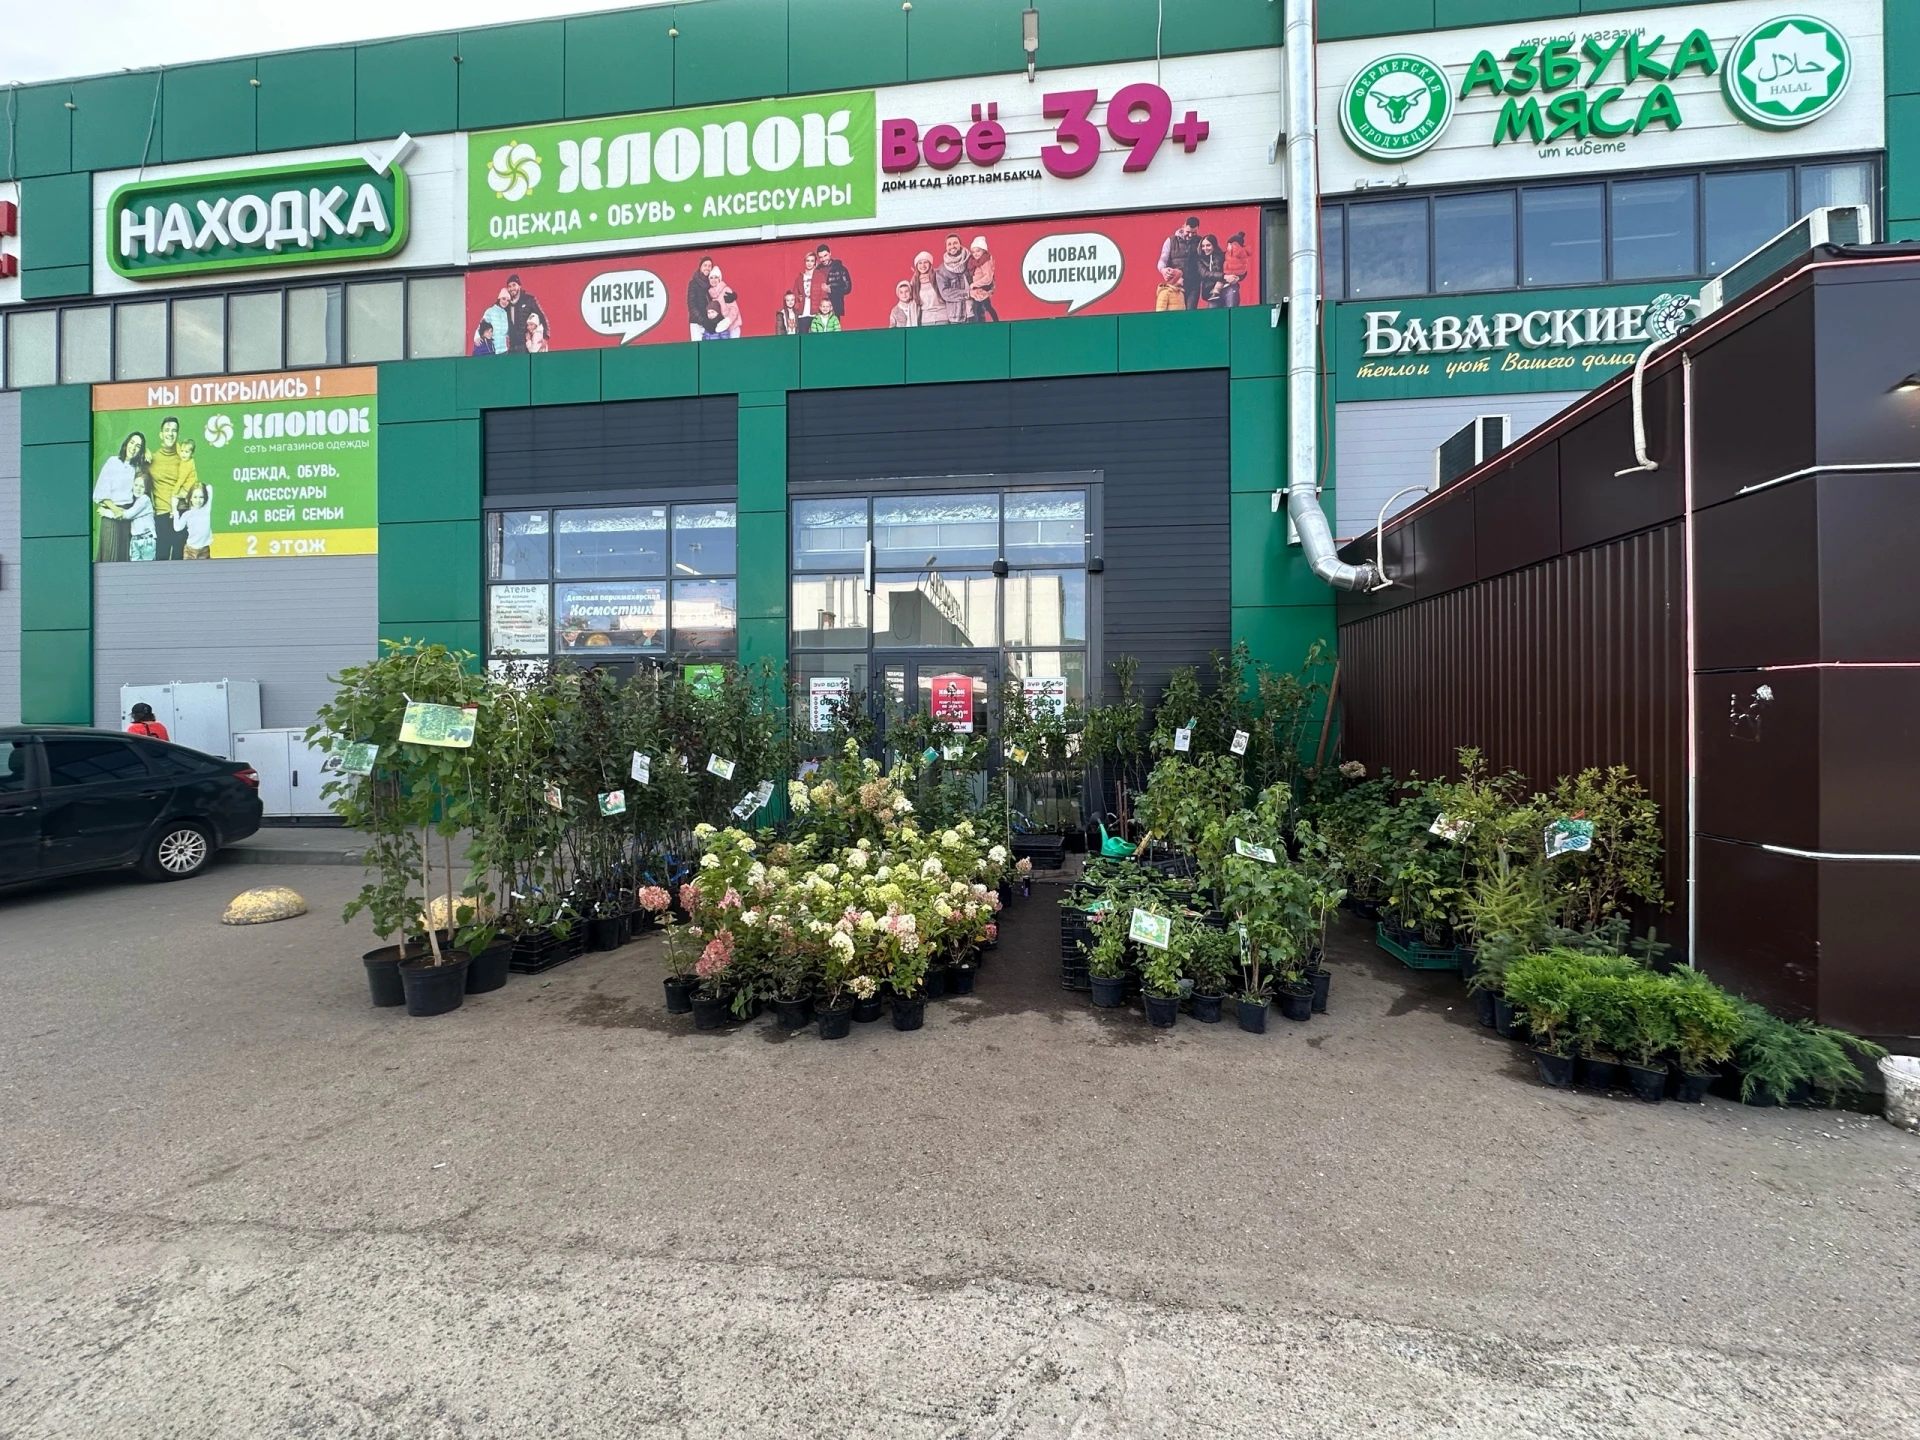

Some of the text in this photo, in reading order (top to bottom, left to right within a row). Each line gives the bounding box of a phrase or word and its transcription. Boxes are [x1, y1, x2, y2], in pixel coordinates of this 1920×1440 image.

[1459, 28, 1718, 102] АЗБУКА
[1758, 53, 1825, 82] حلال
[1355, 60, 1442, 98] ФЕРМЕРСКАЯ
[1770, 82, 1812, 95] HALAL
[1493, 84, 1683, 147] МЯСА
[881, 82, 1210, 180] Всё 39+
[1360, 118, 1436, 148] ПРОДУКЦИЯ
[557, 110, 855, 193] ХЛОПОК
[1538, 141, 1627, 159] ит кибете
[881, 180, 907, 192] ДОМ
[909, 179, 917, 189] И
[920, 178, 942, 189] САД
[946, 174, 976, 186] ЙОРТ
[1003, 169, 1043, 182] БАКЧА
[120, 182, 392, 259] НАХОДКА
[490, 183, 852, 240] ОДЕЖДА ОБУВЬ АКСЕССУАРЫ
[1048, 245, 1097, 263] НОВАЯ
[1028, 264, 1117, 285] КОЛЛЕКЦИЯ
[590, 280, 655, 303] НИЗКИЕ
[601, 303, 648, 327] ЦЕНЫ
[1445, 357, 1490, 379] уют
[1500, 352, 1576, 371] Вашего
[1582, 353, 1636, 372] дома
[147, 385, 180, 407] МЫ
[191, 379, 308, 404] ОТКРЫЛИСЬ
[242, 406, 371, 440] ХЛОПОК
[244, 438, 371, 454] сеть магазинов одежды
[233, 463, 340, 483] ОДЕЖДА, ОБУВЬ,
[245, 485, 327, 502] АКСЕССУАРЫ
[229, 505, 345, 526] ДЛЯ ВСЕЙ СЕМЬИ
[246, 534, 326, 556] 2 этаж
[503, 585, 537, 594] Ателье
